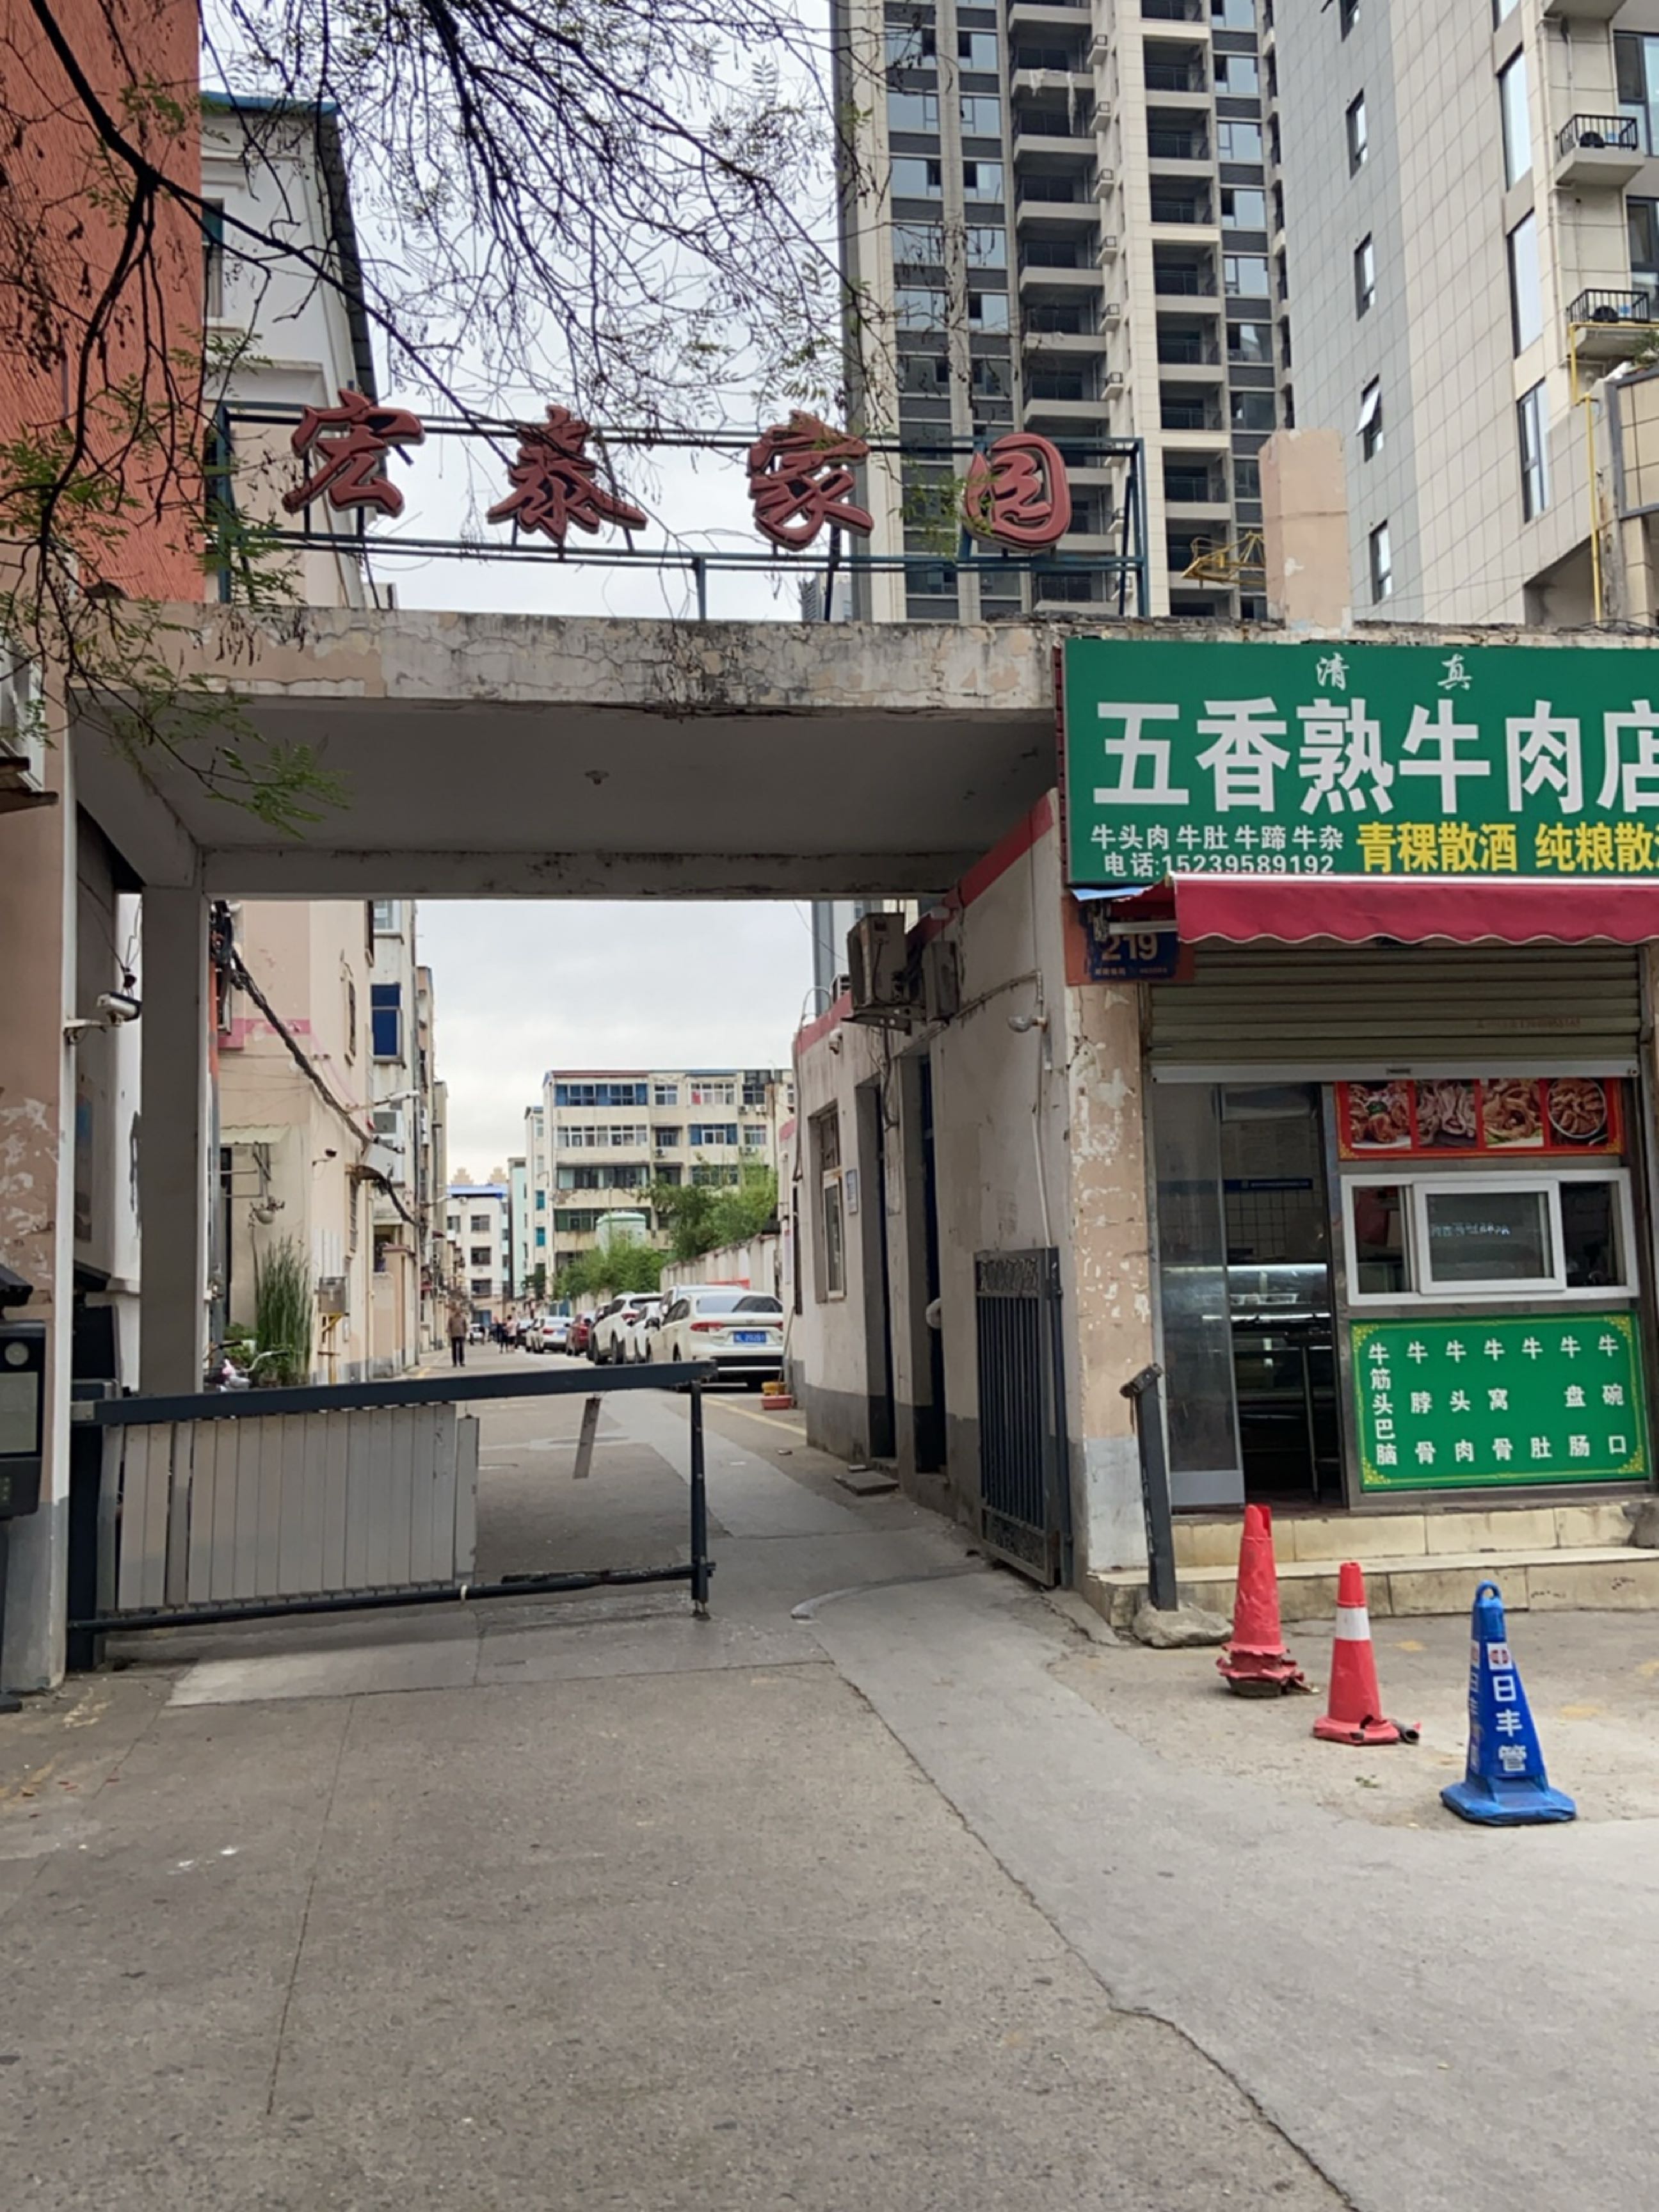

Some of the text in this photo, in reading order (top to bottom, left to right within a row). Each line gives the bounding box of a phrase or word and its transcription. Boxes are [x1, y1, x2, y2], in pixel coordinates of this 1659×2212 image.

[280, 390, 1073, 556] 宏泰家园
[1315, 653, 1472, 691] 清真
[1093, 696, 1659, 815] 五香熟牛肉店
[1091, 824, 1343, 851] 牛头肉 牛肚 牛蹄 牛杂
[1356, 821, 1659, 873] 青稞散酒 纯粮散
[1102, 933, 1158, 961] 219
[1493, 1675, 1527, 1772] 日丰管
